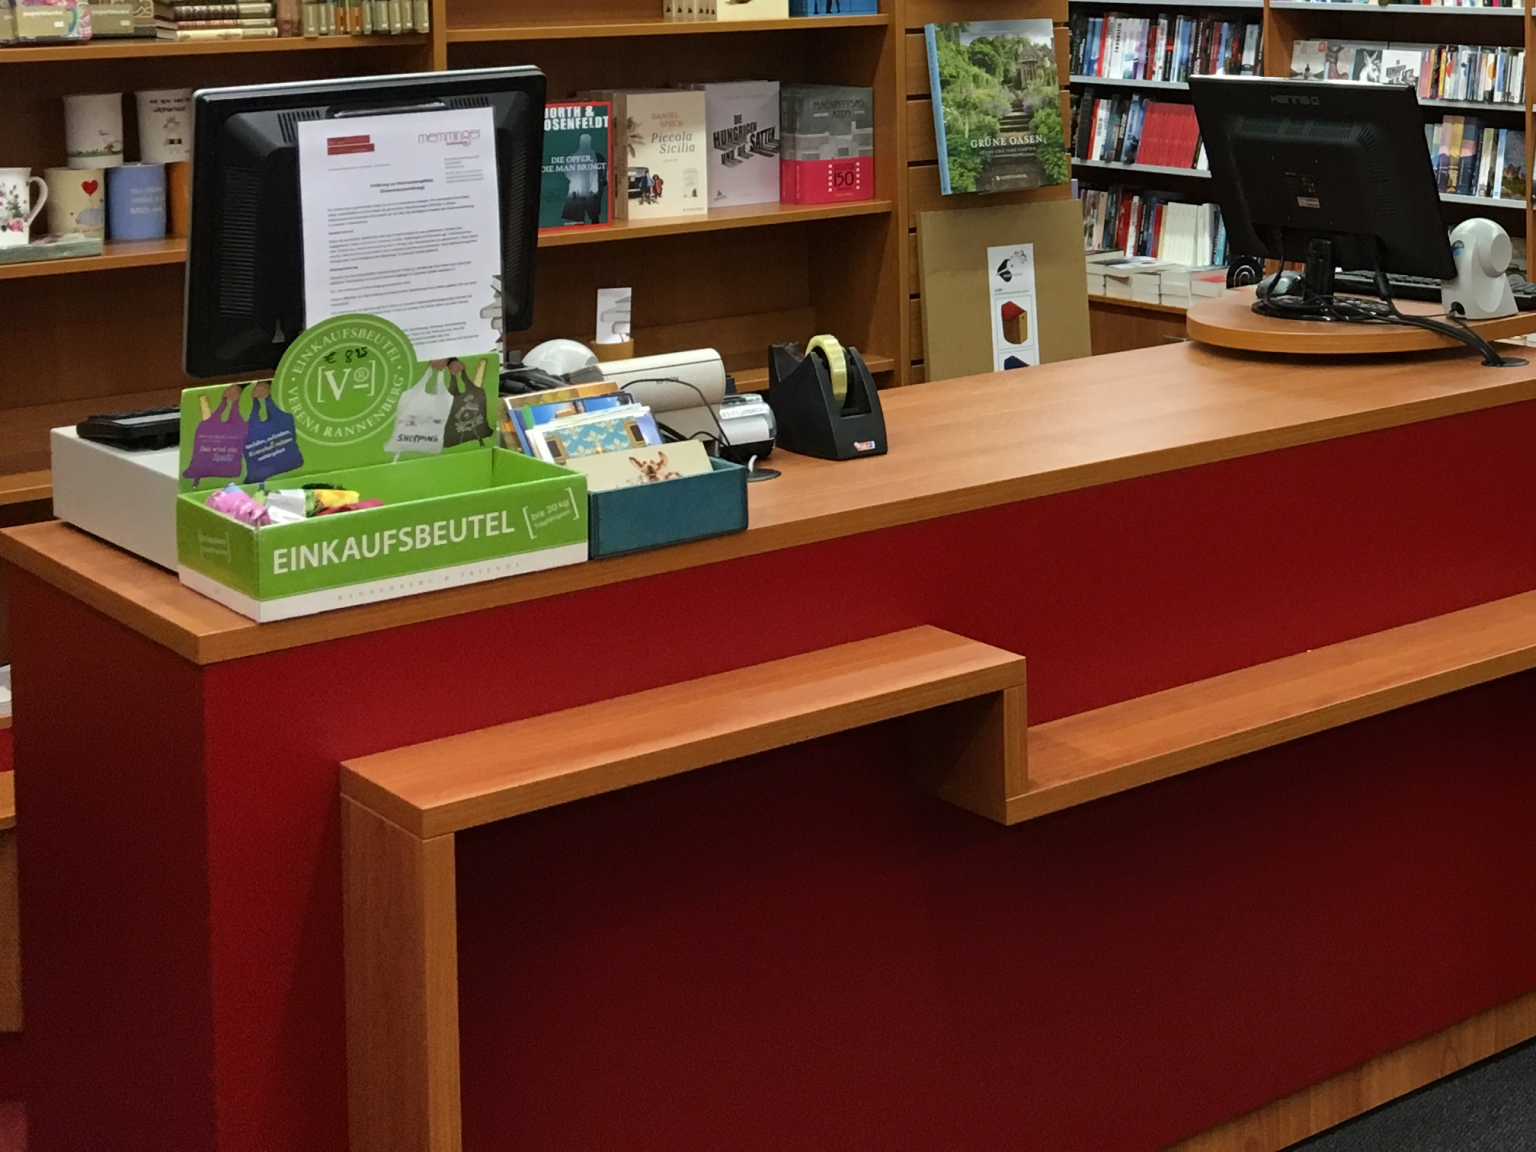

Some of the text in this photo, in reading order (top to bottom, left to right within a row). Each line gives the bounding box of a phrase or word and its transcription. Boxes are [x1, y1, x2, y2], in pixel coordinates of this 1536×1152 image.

[585, 106, 595, 117] &
[651, 131, 692, 144] Piccola
[713, 121, 757, 149] HUNGRIGEN
[970, 134, 1043, 148] GRÜNE OASEN
[659, 143, 696, 154] Sicilia
[555, 163, 606, 173] MAN BRINGT
[833, 171, 854, 187] 150
[293, 327, 400, 375] EINKAUFSBEUTEL
[323, 352, 337, 364] €
[288, 374, 404, 437] VERENA RANNENBERG
[397, 433, 439, 444] SHOPPING
[272, 509, 515, 576] EINKAUFSBEUTEL
